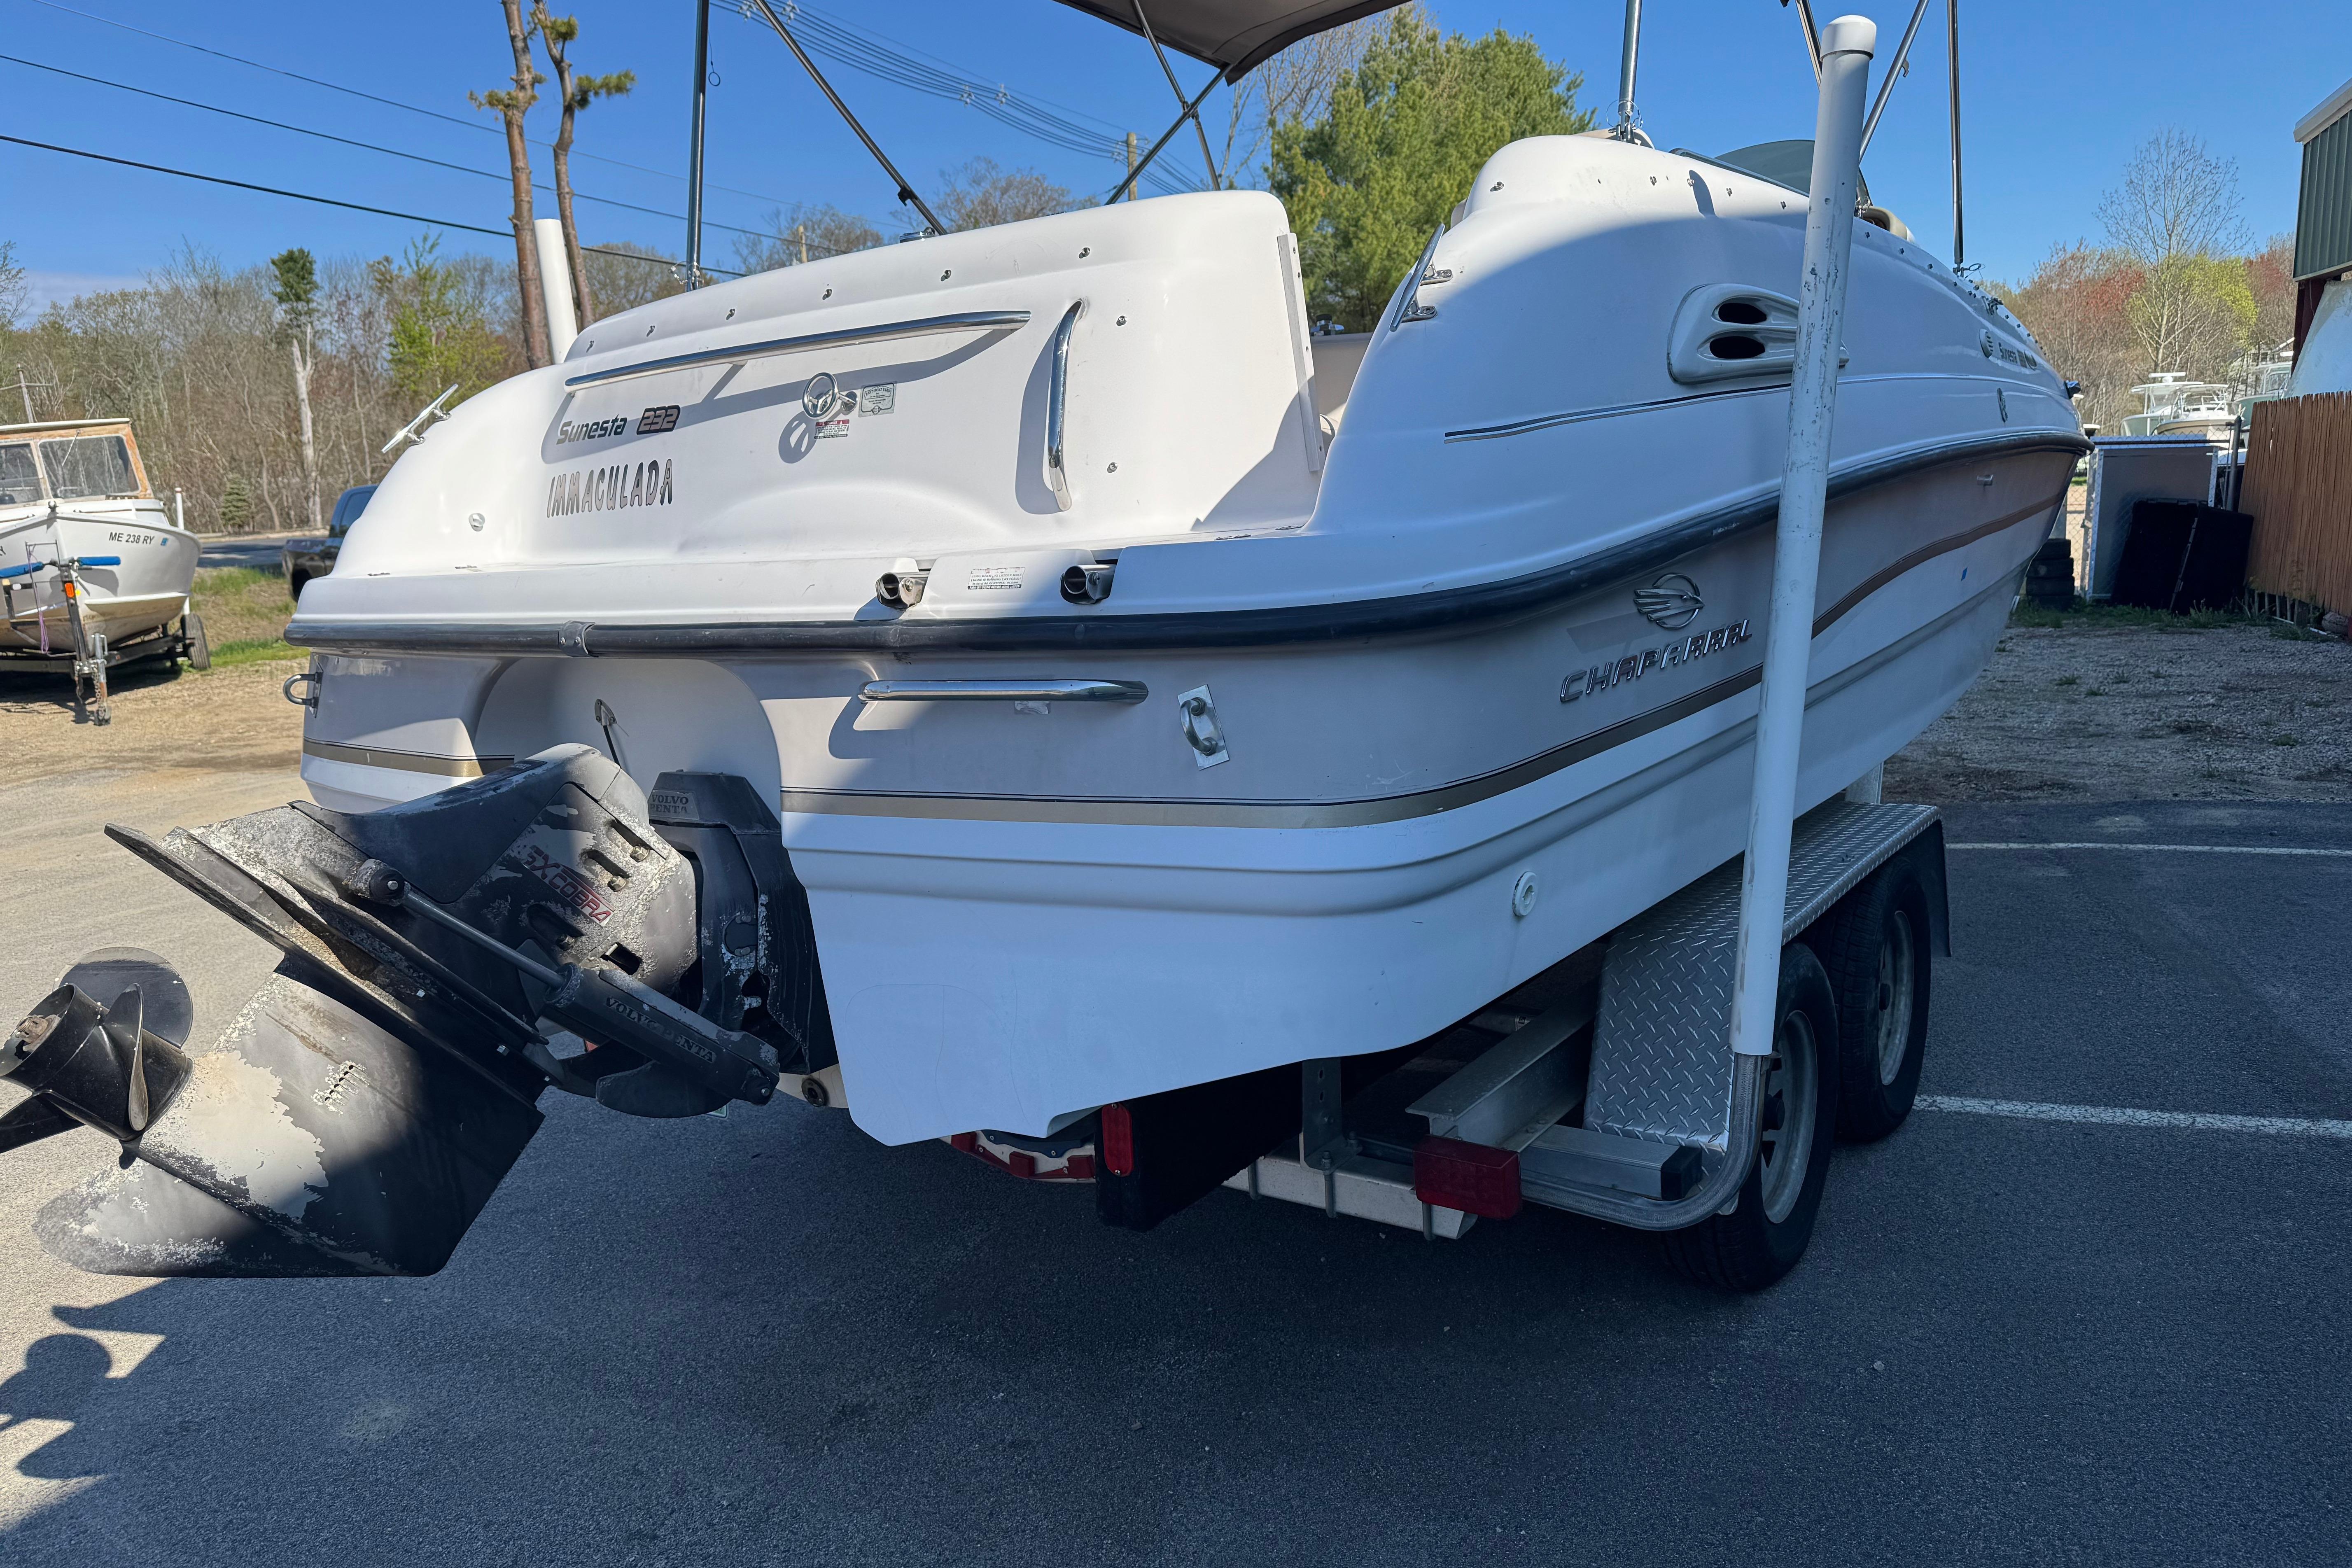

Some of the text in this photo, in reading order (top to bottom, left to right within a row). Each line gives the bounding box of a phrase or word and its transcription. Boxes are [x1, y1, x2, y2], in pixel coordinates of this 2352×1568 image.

[556, 409, 679, 445] Sunesta 232
[547, 459, 672, 518] IMMACULADA
[109, 532, 155, 545] ME 238 RY
[1560, 619, 1752, 702] CHAPARRAL
[650, 803, 688, 814] PENTA
[652, 795, 688, 805] VOLVO
[548, 873, 611, 923] COBRA
